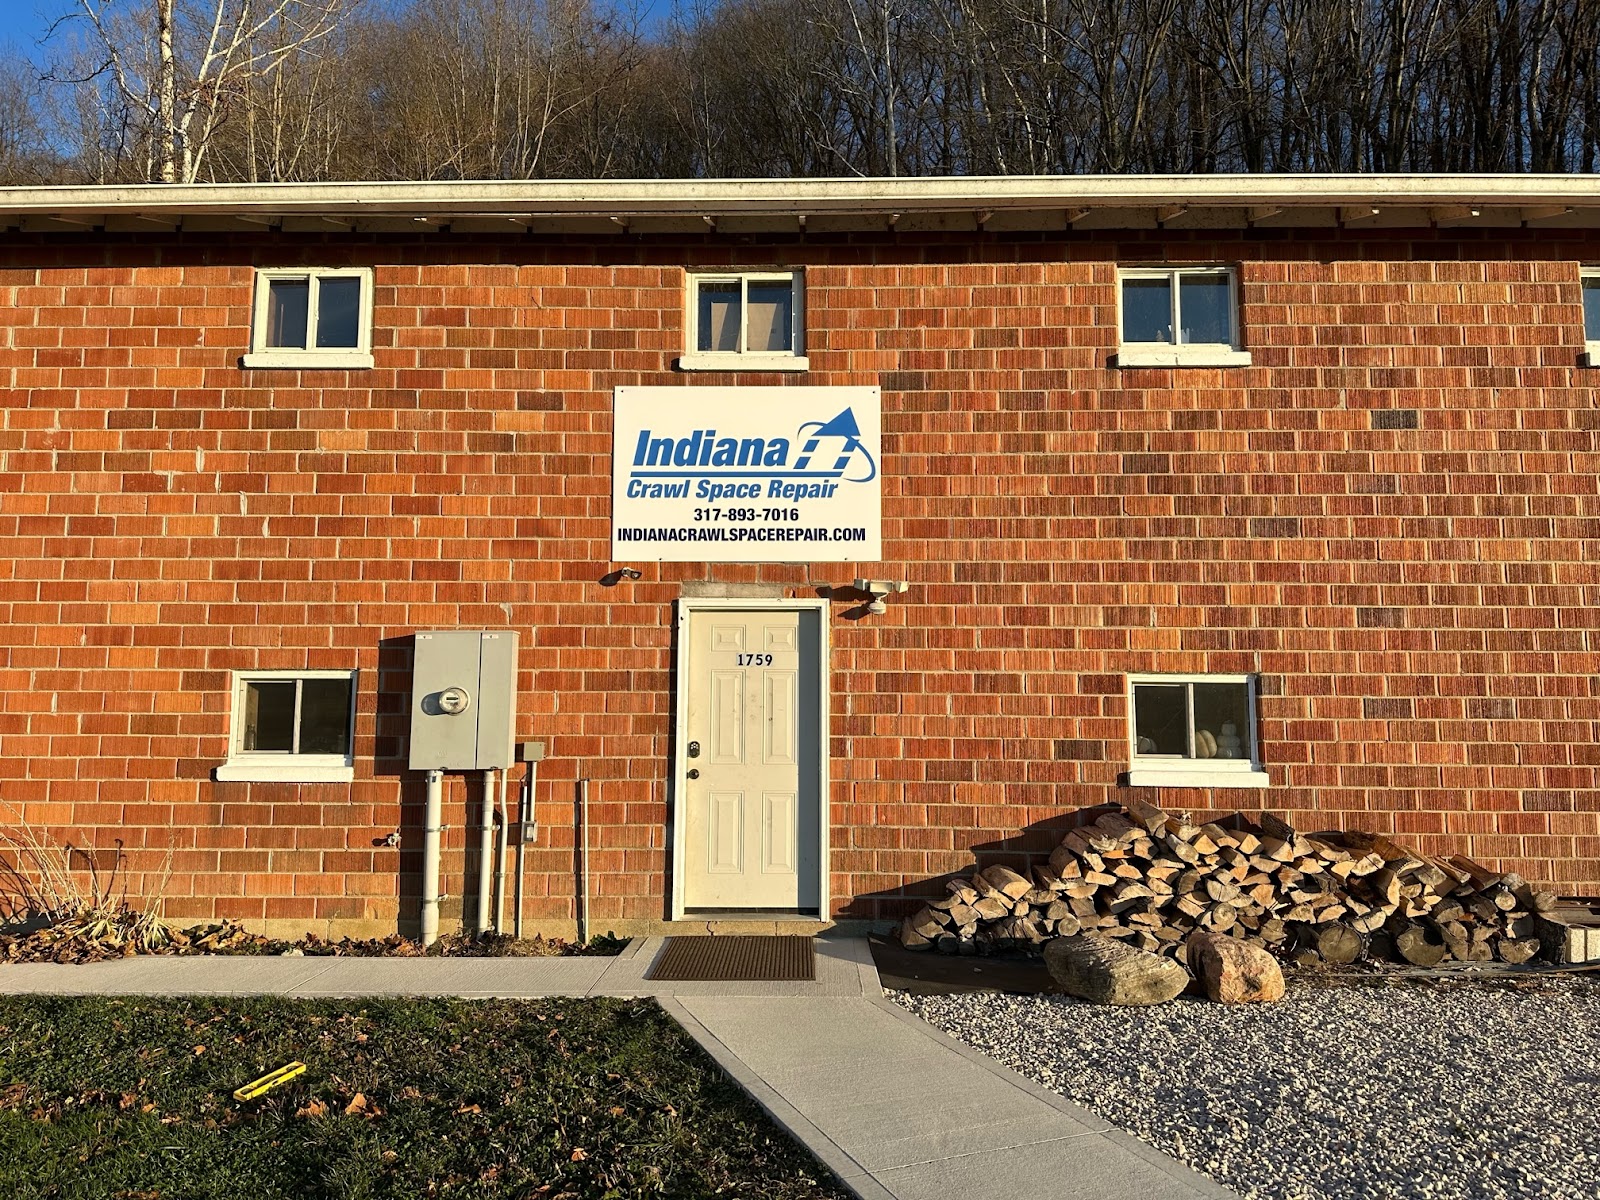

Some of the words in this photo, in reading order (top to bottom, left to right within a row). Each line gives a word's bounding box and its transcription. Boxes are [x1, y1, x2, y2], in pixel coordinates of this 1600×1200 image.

[632, 430, 790, 467] Indiana
[626, 480, 691, 499] Crawl
[695, 480, 762, 503] Space
[767, 480, 839, 503] Repair
[693, 508, 799, 522] 317-893-7016
[617, 527, 866, 542] INDIANACRAWLSPACEREPAIR.COM
[737, 654, 773, 667] 1759
